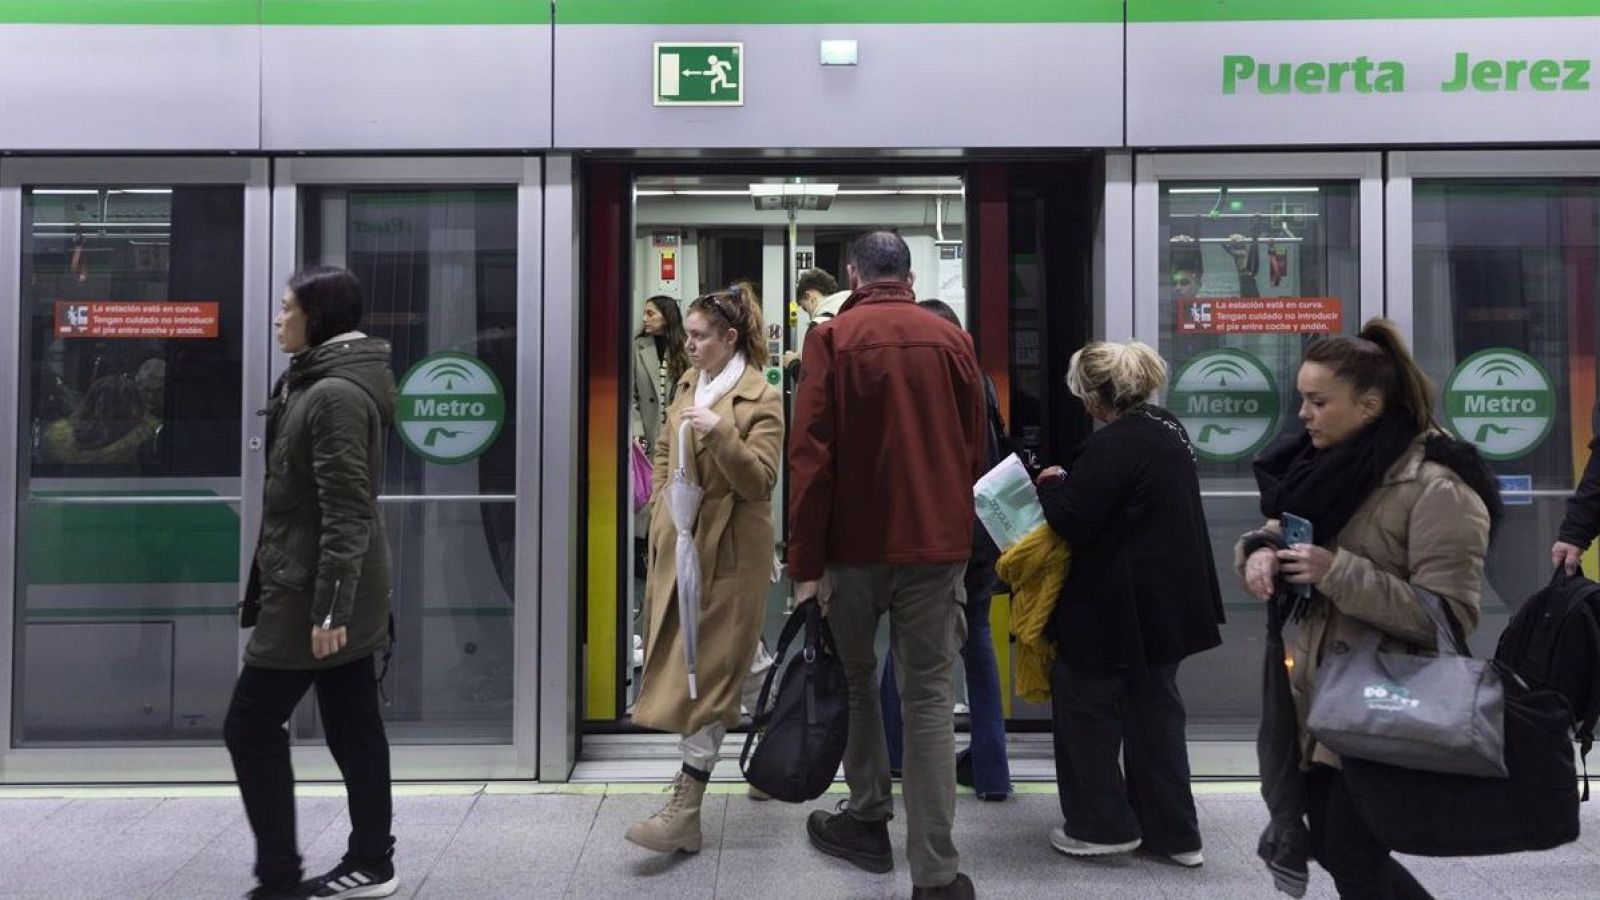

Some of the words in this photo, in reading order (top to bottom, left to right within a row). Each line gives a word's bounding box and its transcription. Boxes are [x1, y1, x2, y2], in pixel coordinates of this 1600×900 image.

[1221, 54, 1405, 96] Puerta
[1440, 52, 1592, 93] Jerez
[92, 304, 104, 313] La
[105, 304, 141, 313] estación
[142, 305, 161, 313] está
[1228, 301, 1264, 309] estación
[1265, 301, 1284, 309] está
[93, 316, 124, 325] Tengan
[125, 316, 160, 324] cuidado
[174, 316, 215, 325] introducir
[1216, 312, 1248, 321] Tengan
[1249, 312, 1283, 320] cuidado
[1297, 312, 1339, 320] introducir
[92, 326, 101, 334] el
[102, 326, 116, 335] pie
[118, 326, 140, 334] entre
[141, 326, 168, 334] coche
[169, 328, 175, 336] y
[1226, 323, 1240, 332] pie
[1293, 324, 1299, 332] y
[413, 399, 485, 417] Metro
[1187, 395, 1259, 413] Metro
[1464, 395, 1537, 413] Metro
